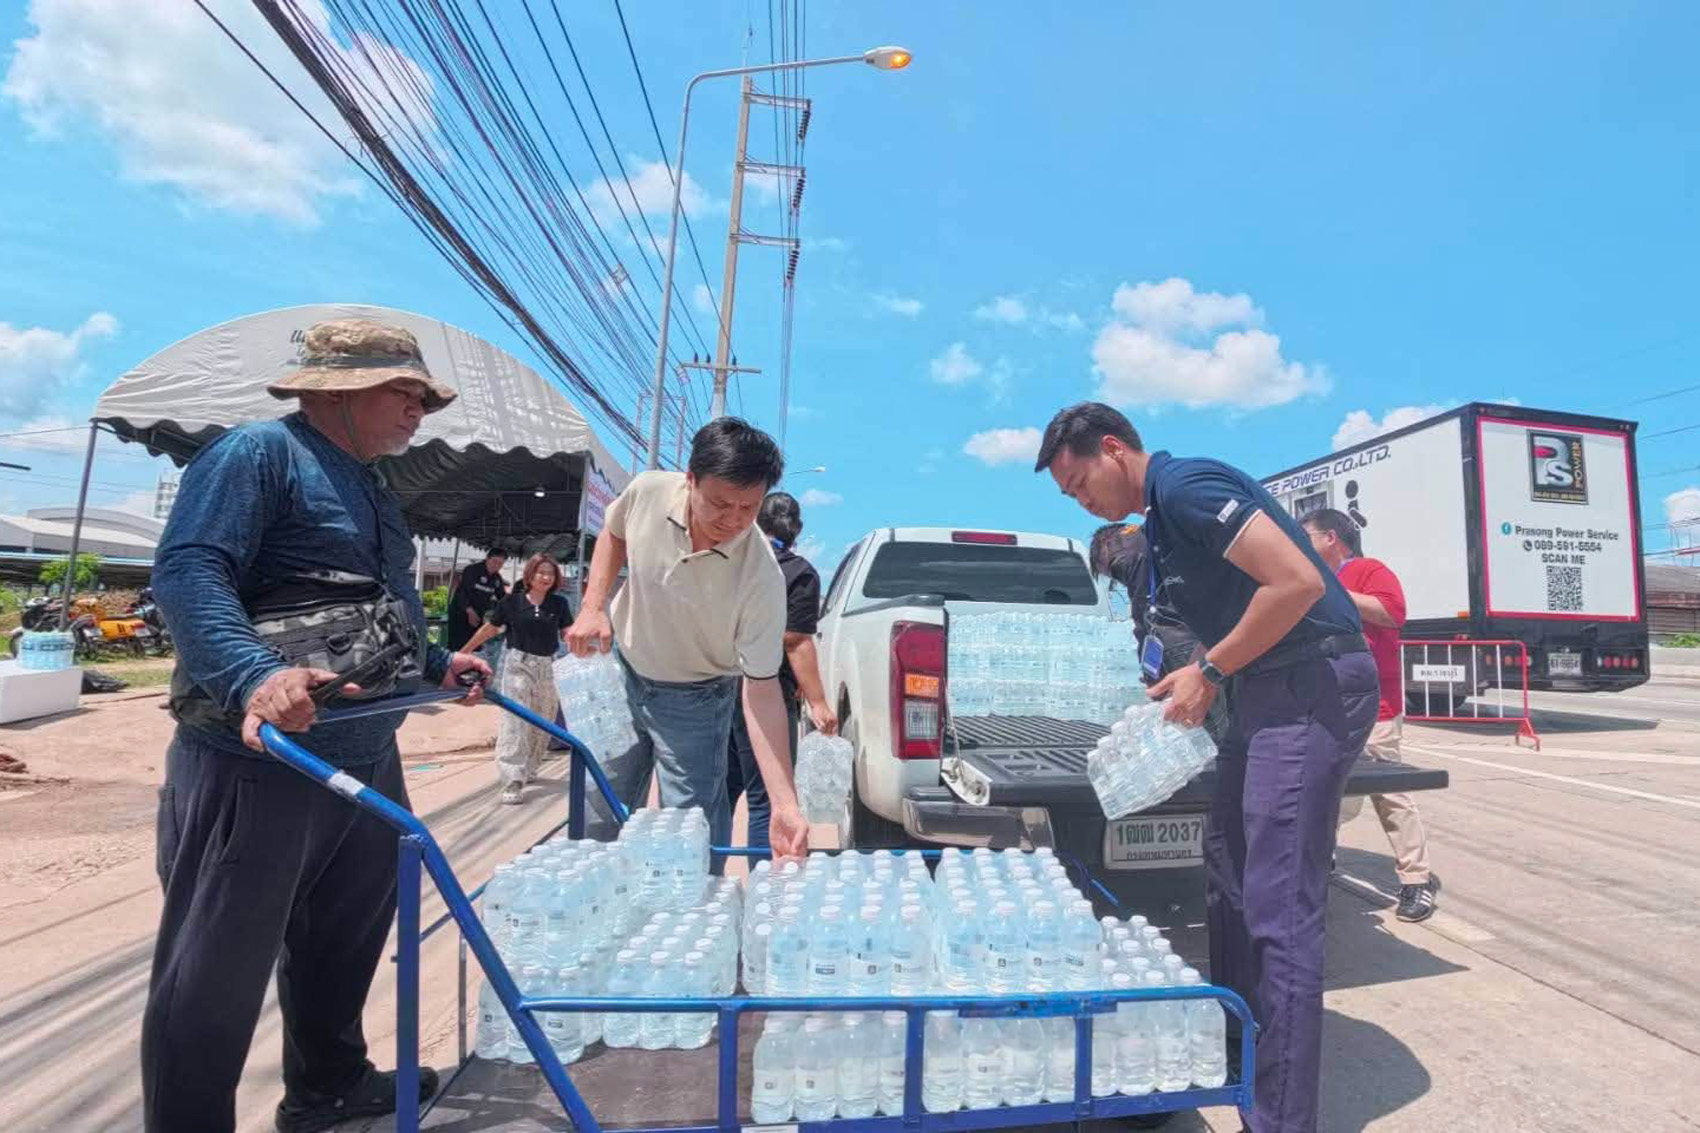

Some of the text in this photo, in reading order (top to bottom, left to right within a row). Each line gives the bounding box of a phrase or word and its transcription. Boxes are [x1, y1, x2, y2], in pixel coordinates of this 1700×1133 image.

[1571, 441, 1583, 488] POWER
[1282, 466, 1330, 491] POWER
[1515, 525, 1619, 540] Prasong Power Service
[1541, 553, 1586, 564] SCAN ME
[1157, 821, 1200, 843] 2037
